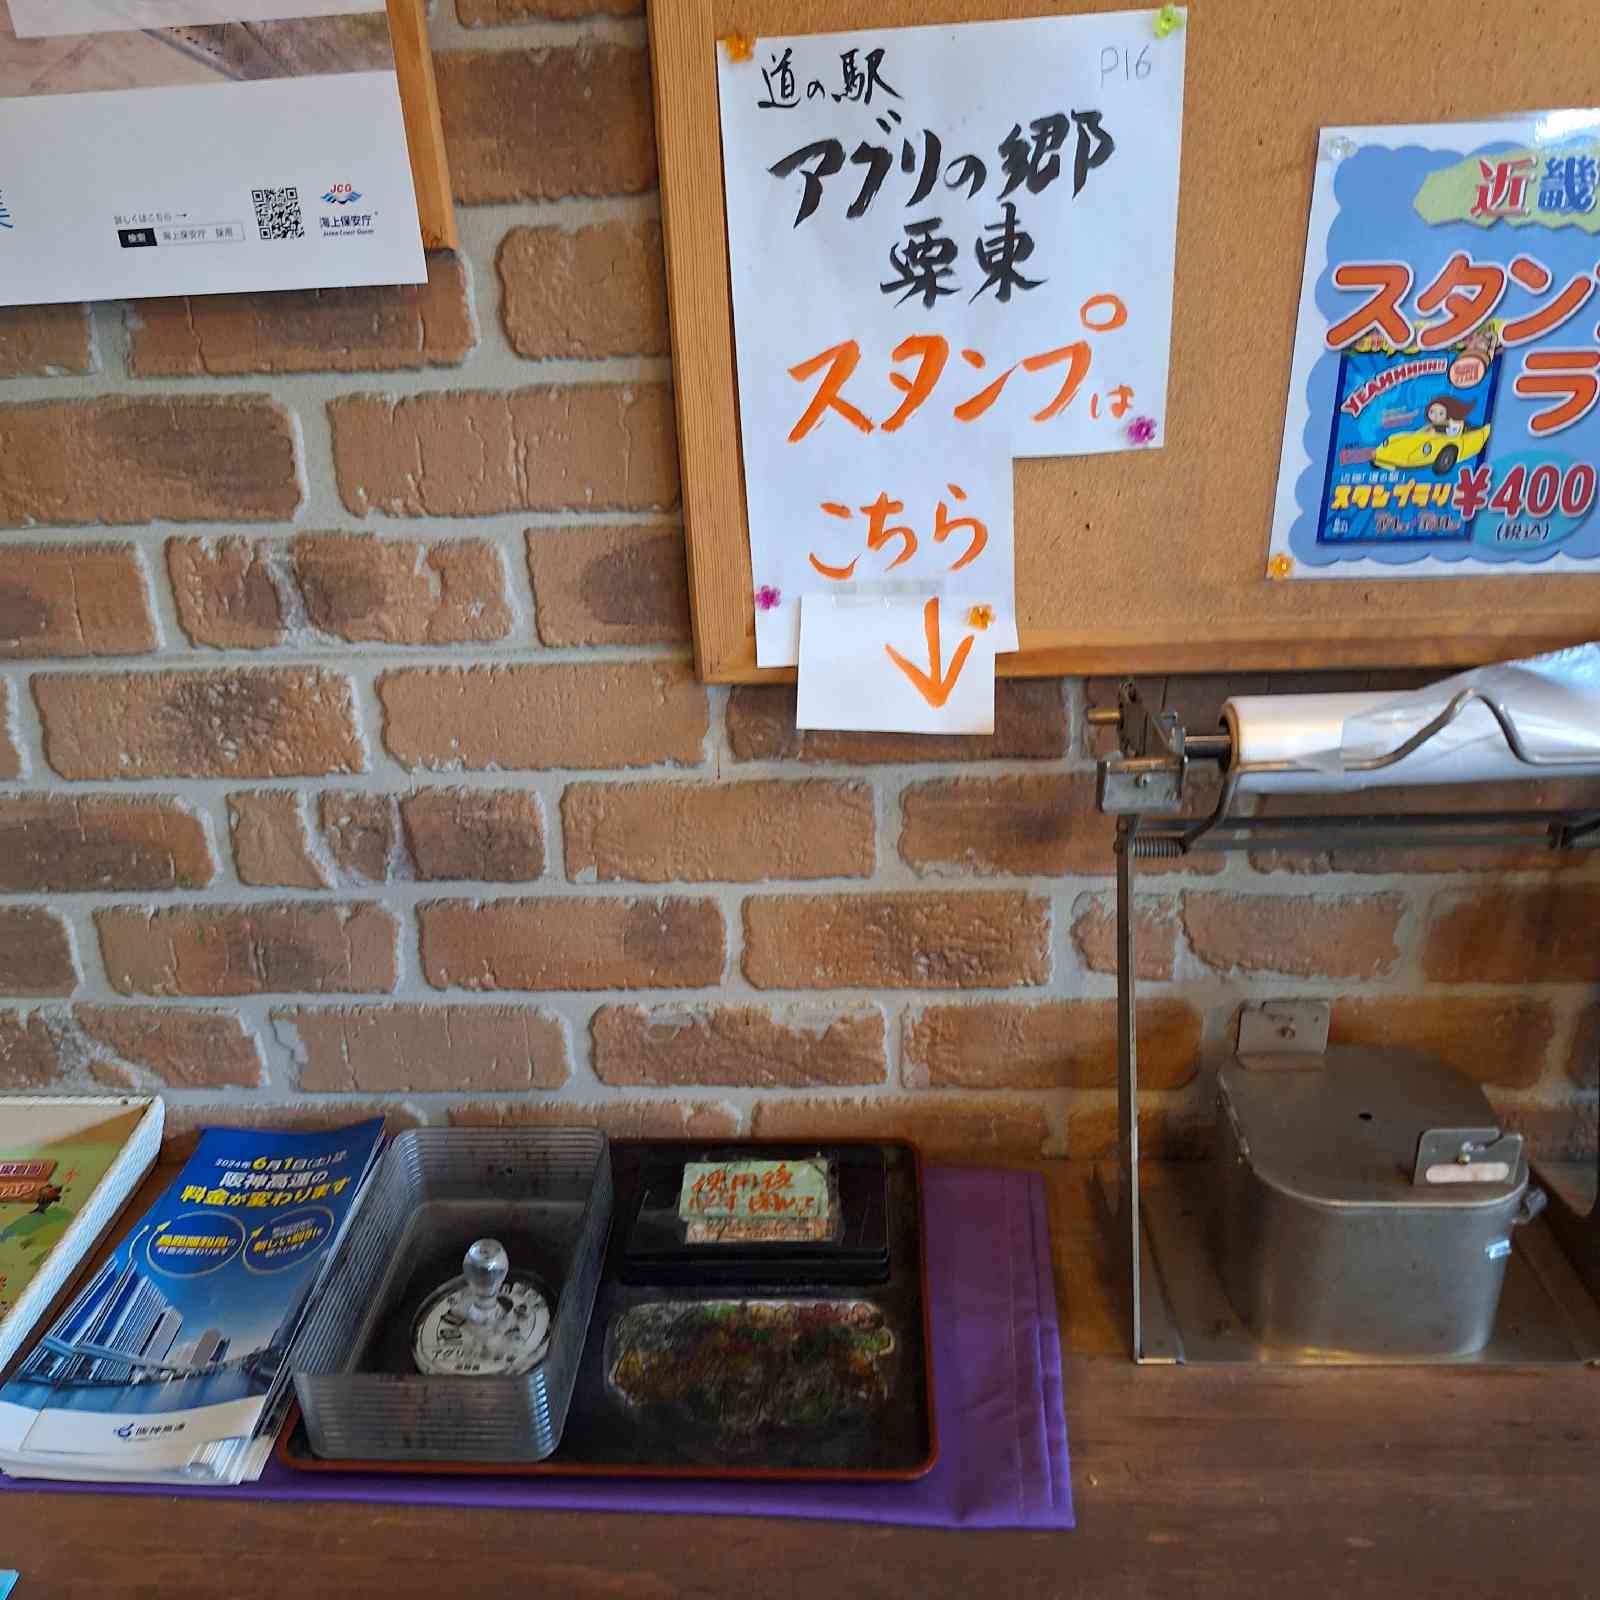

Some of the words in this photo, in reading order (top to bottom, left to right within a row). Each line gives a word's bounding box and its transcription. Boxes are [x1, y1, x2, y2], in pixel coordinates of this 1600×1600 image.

[758, 48, 903, 109] 道の駅
[1100, 45, 1152, 87] P16
[1470, 155, 1600, 217] 近畿
[320, 214, 372, 228] 海上保安庁
[880, 202, 1048, 310] 栗東
[1325, 252, 1600, 348] スタン
[786, 293, 1135, 443] スタンプは
[1452, 464, 1597, 520] ¥400
[808, 483, 989, 579] こちら
